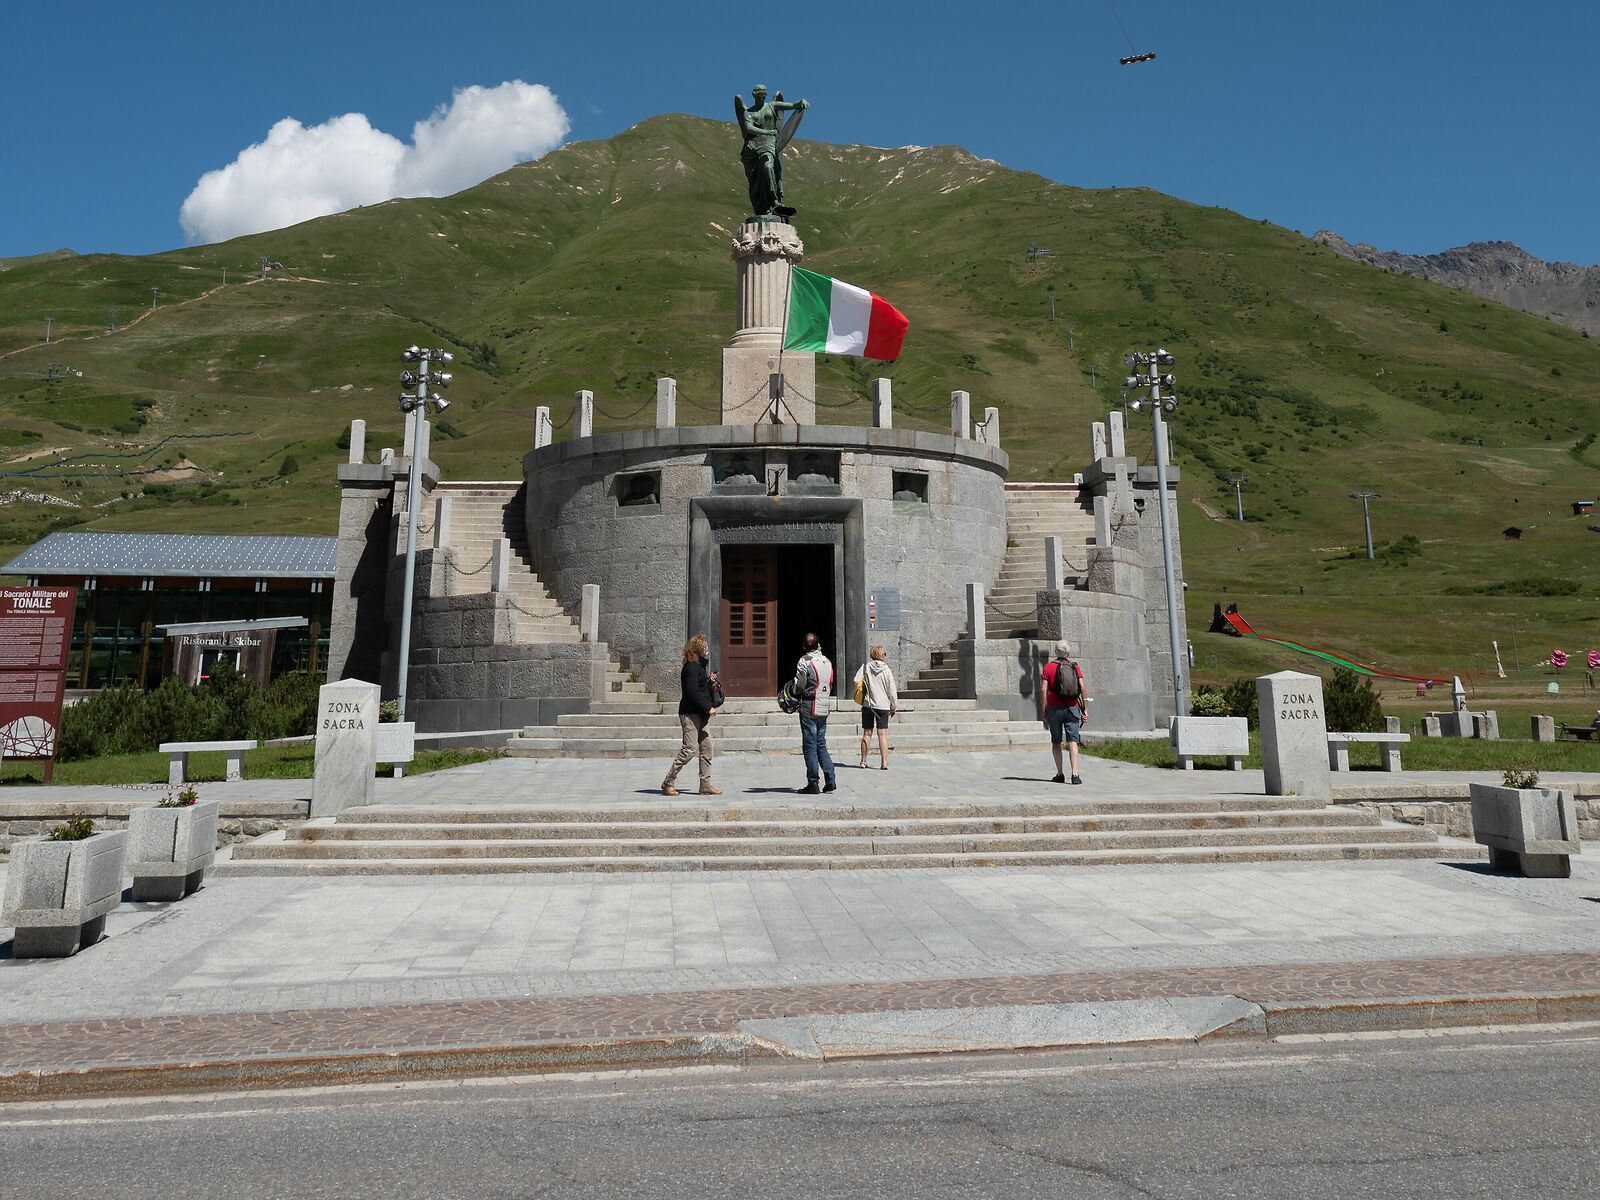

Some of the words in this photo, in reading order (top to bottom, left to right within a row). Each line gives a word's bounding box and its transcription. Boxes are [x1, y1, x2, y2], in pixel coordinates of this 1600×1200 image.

[783, 522, 838, 531] MILITARE
[4, 590, 31, 598] Sacrario
[32, 590, 57, 598] Militare
[58, 590, 69, 598] del
[13, 597, 52, 608] TONALE
[183, 636, 227, 646] Ristorante
[234, 636, 262, 647] Skibar
[1283, 694, 1314, 705] ZONA
[328, 702, 360, 713] ZONA
[1281, 709, 1319, 720] SACRA
[323, 719, 364, 730] SACRA
